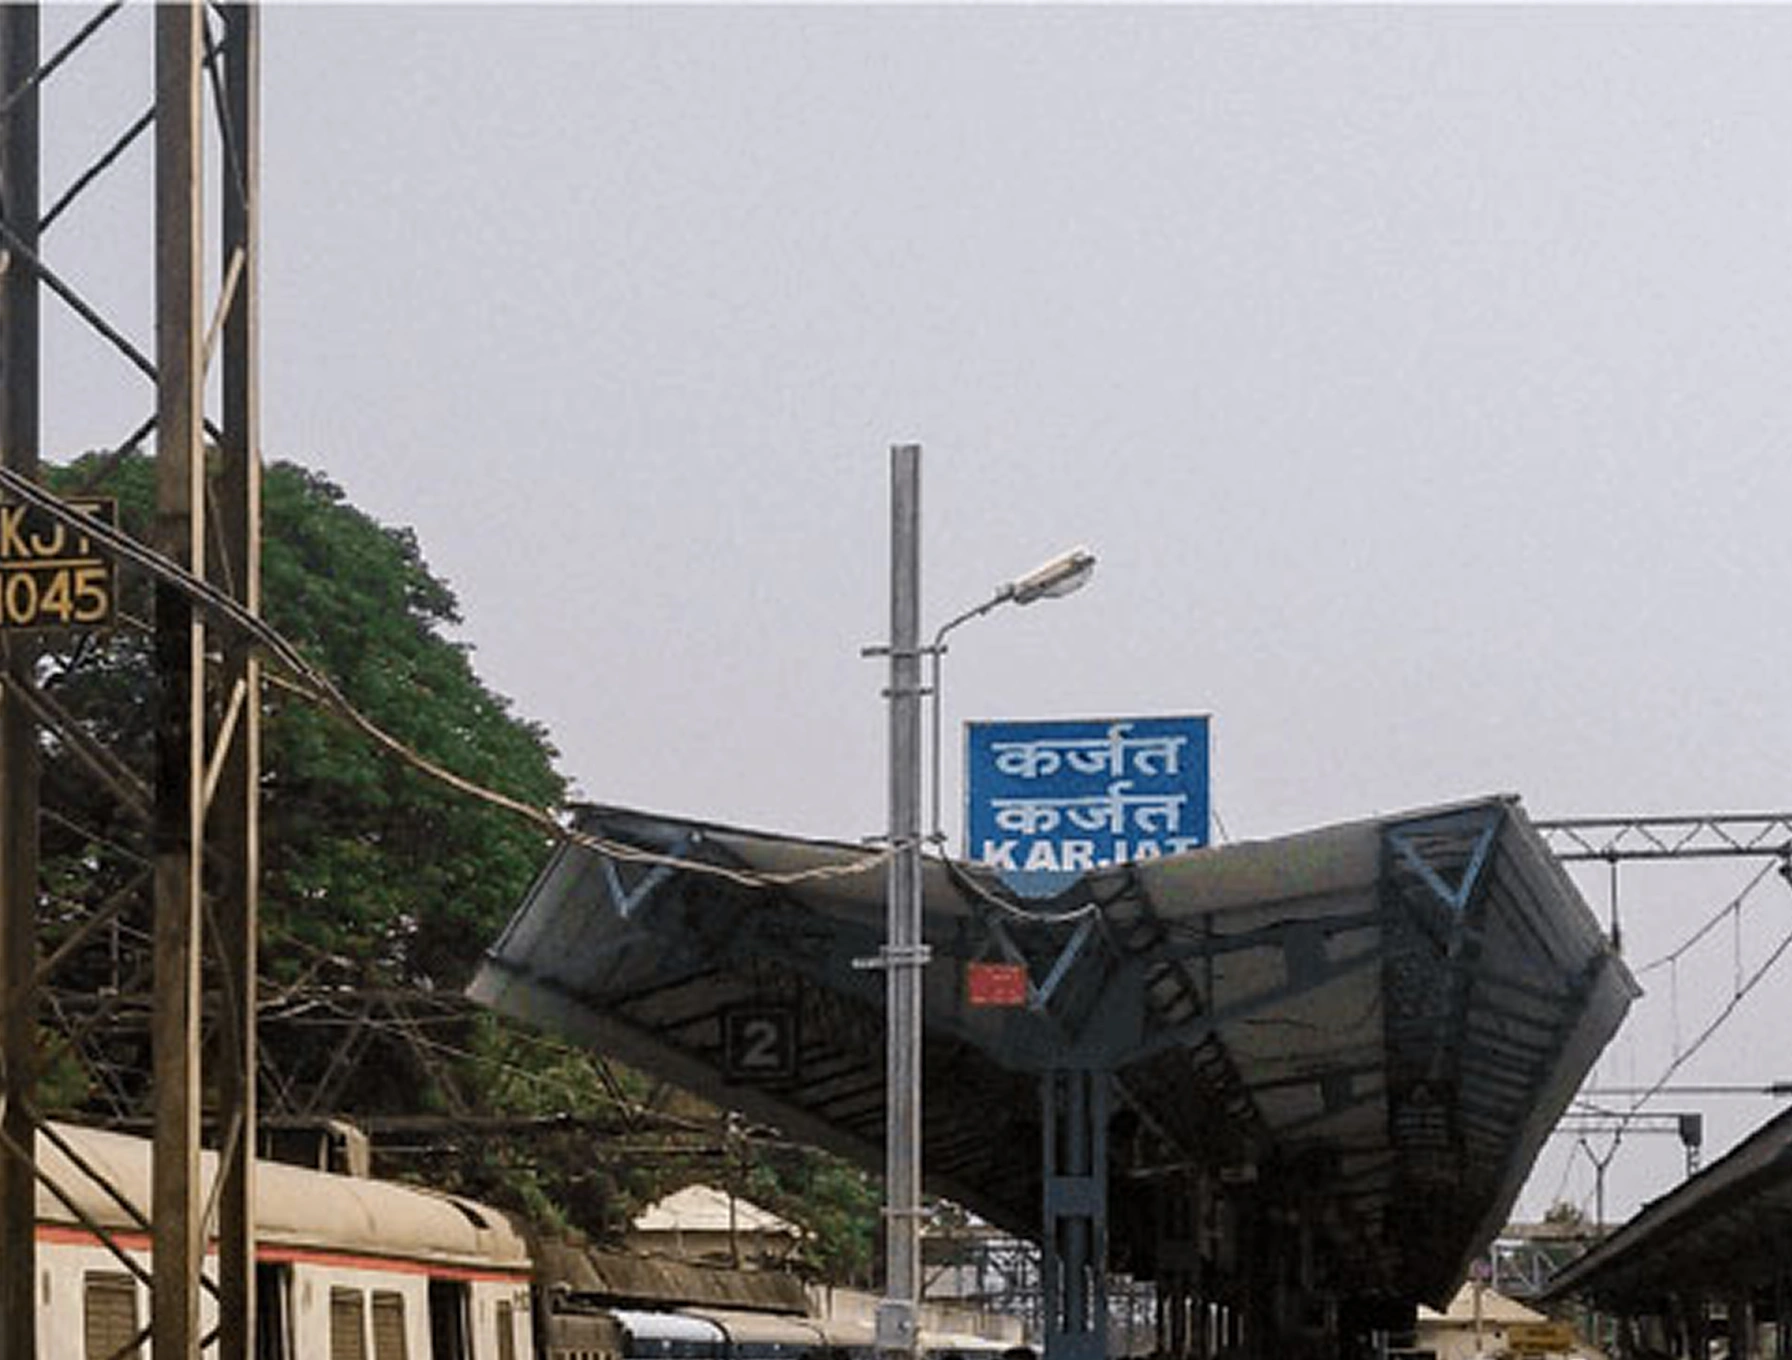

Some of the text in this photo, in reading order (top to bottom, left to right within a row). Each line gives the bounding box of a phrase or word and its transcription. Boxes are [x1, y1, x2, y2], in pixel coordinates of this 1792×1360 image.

[990, 723, 1188, 778] कर्जत
[990, 780, 1187, 835] कर्जत
[740, 1019, 780, 1067] 2
